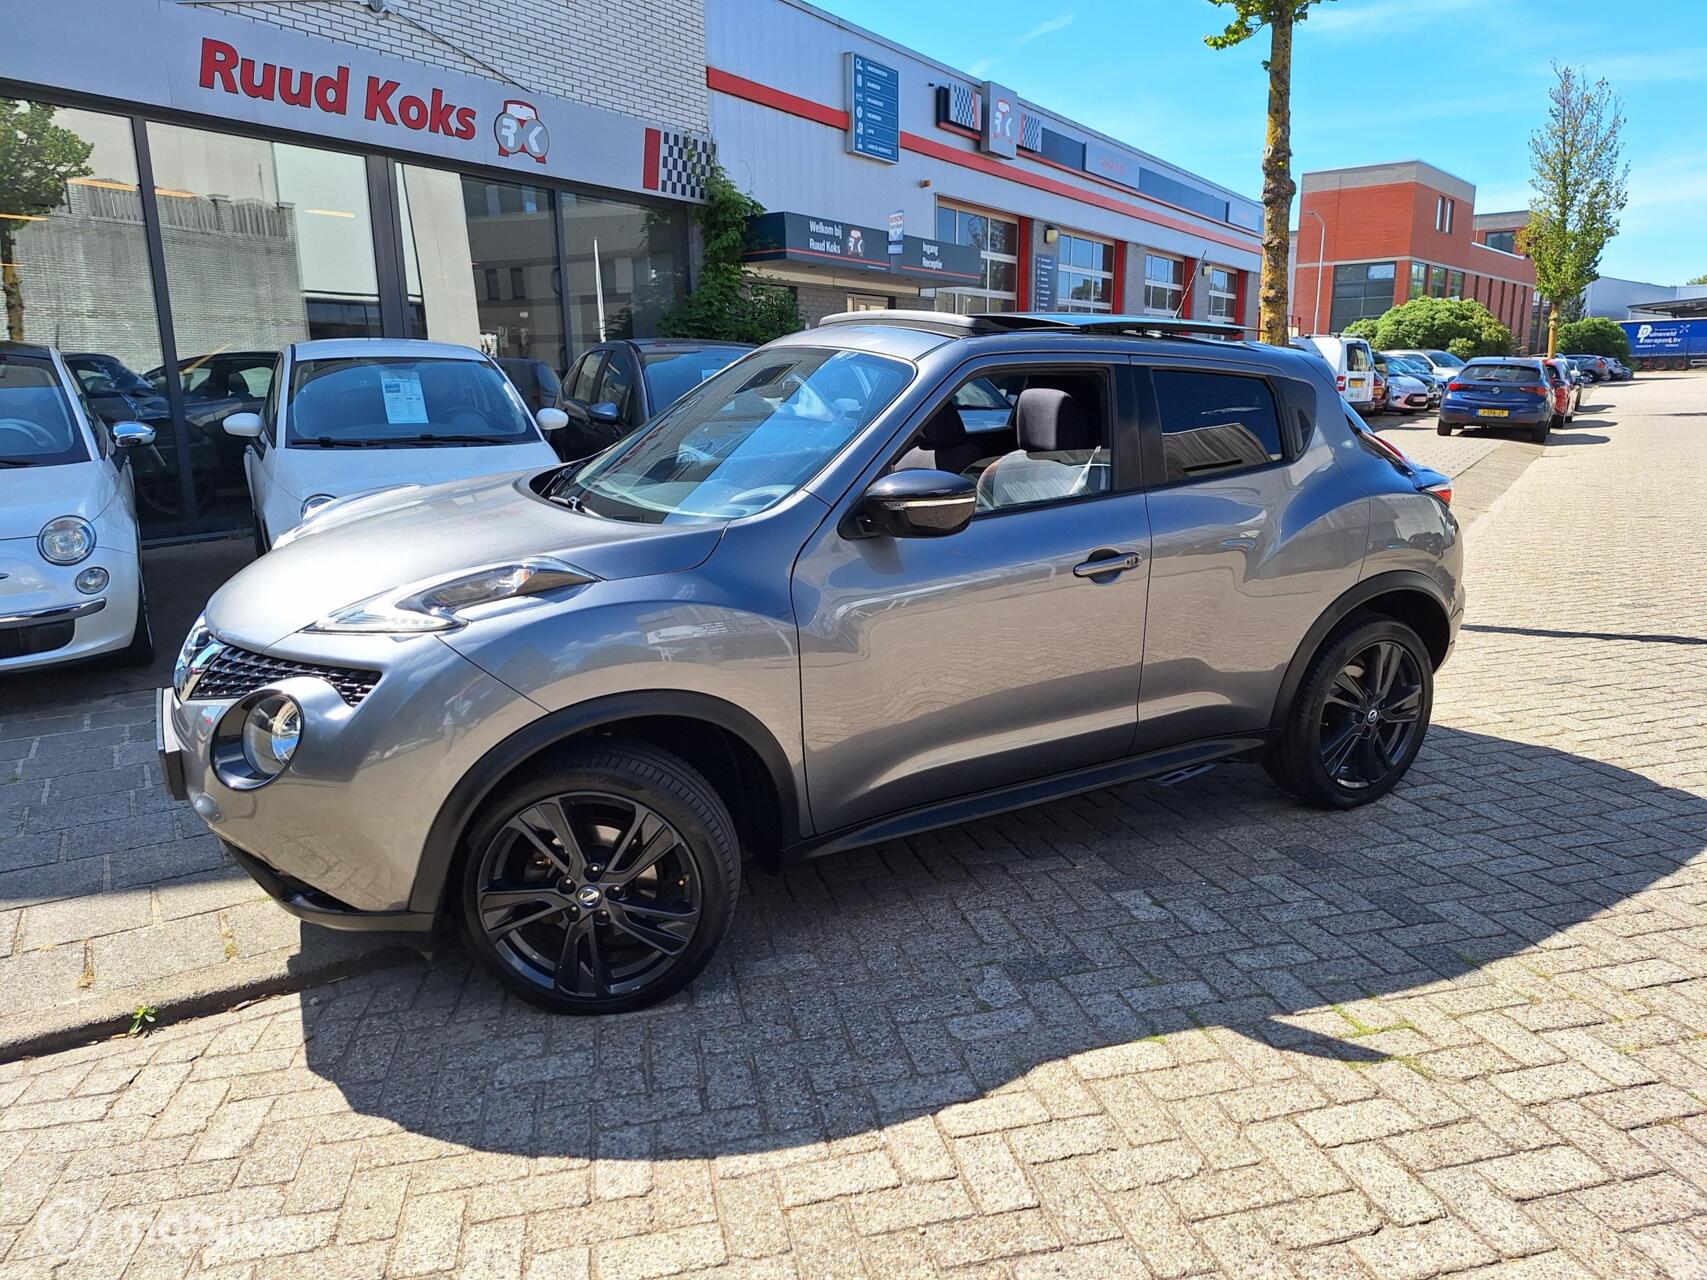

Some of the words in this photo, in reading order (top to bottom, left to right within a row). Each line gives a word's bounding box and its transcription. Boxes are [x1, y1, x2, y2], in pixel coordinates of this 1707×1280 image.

[199, 37, 350, 116] Ruud
[364, 75, 477, 141] Koks
[809, 220, 834, 236] Welkom
[834, 224, 843, 239] bij
[809, 238, 826, 251] Ruud
[826, 240, 841, 254] Koks
[922, 241, 939, 256] Ingang
[922, 257, 943, 270] Receptie
